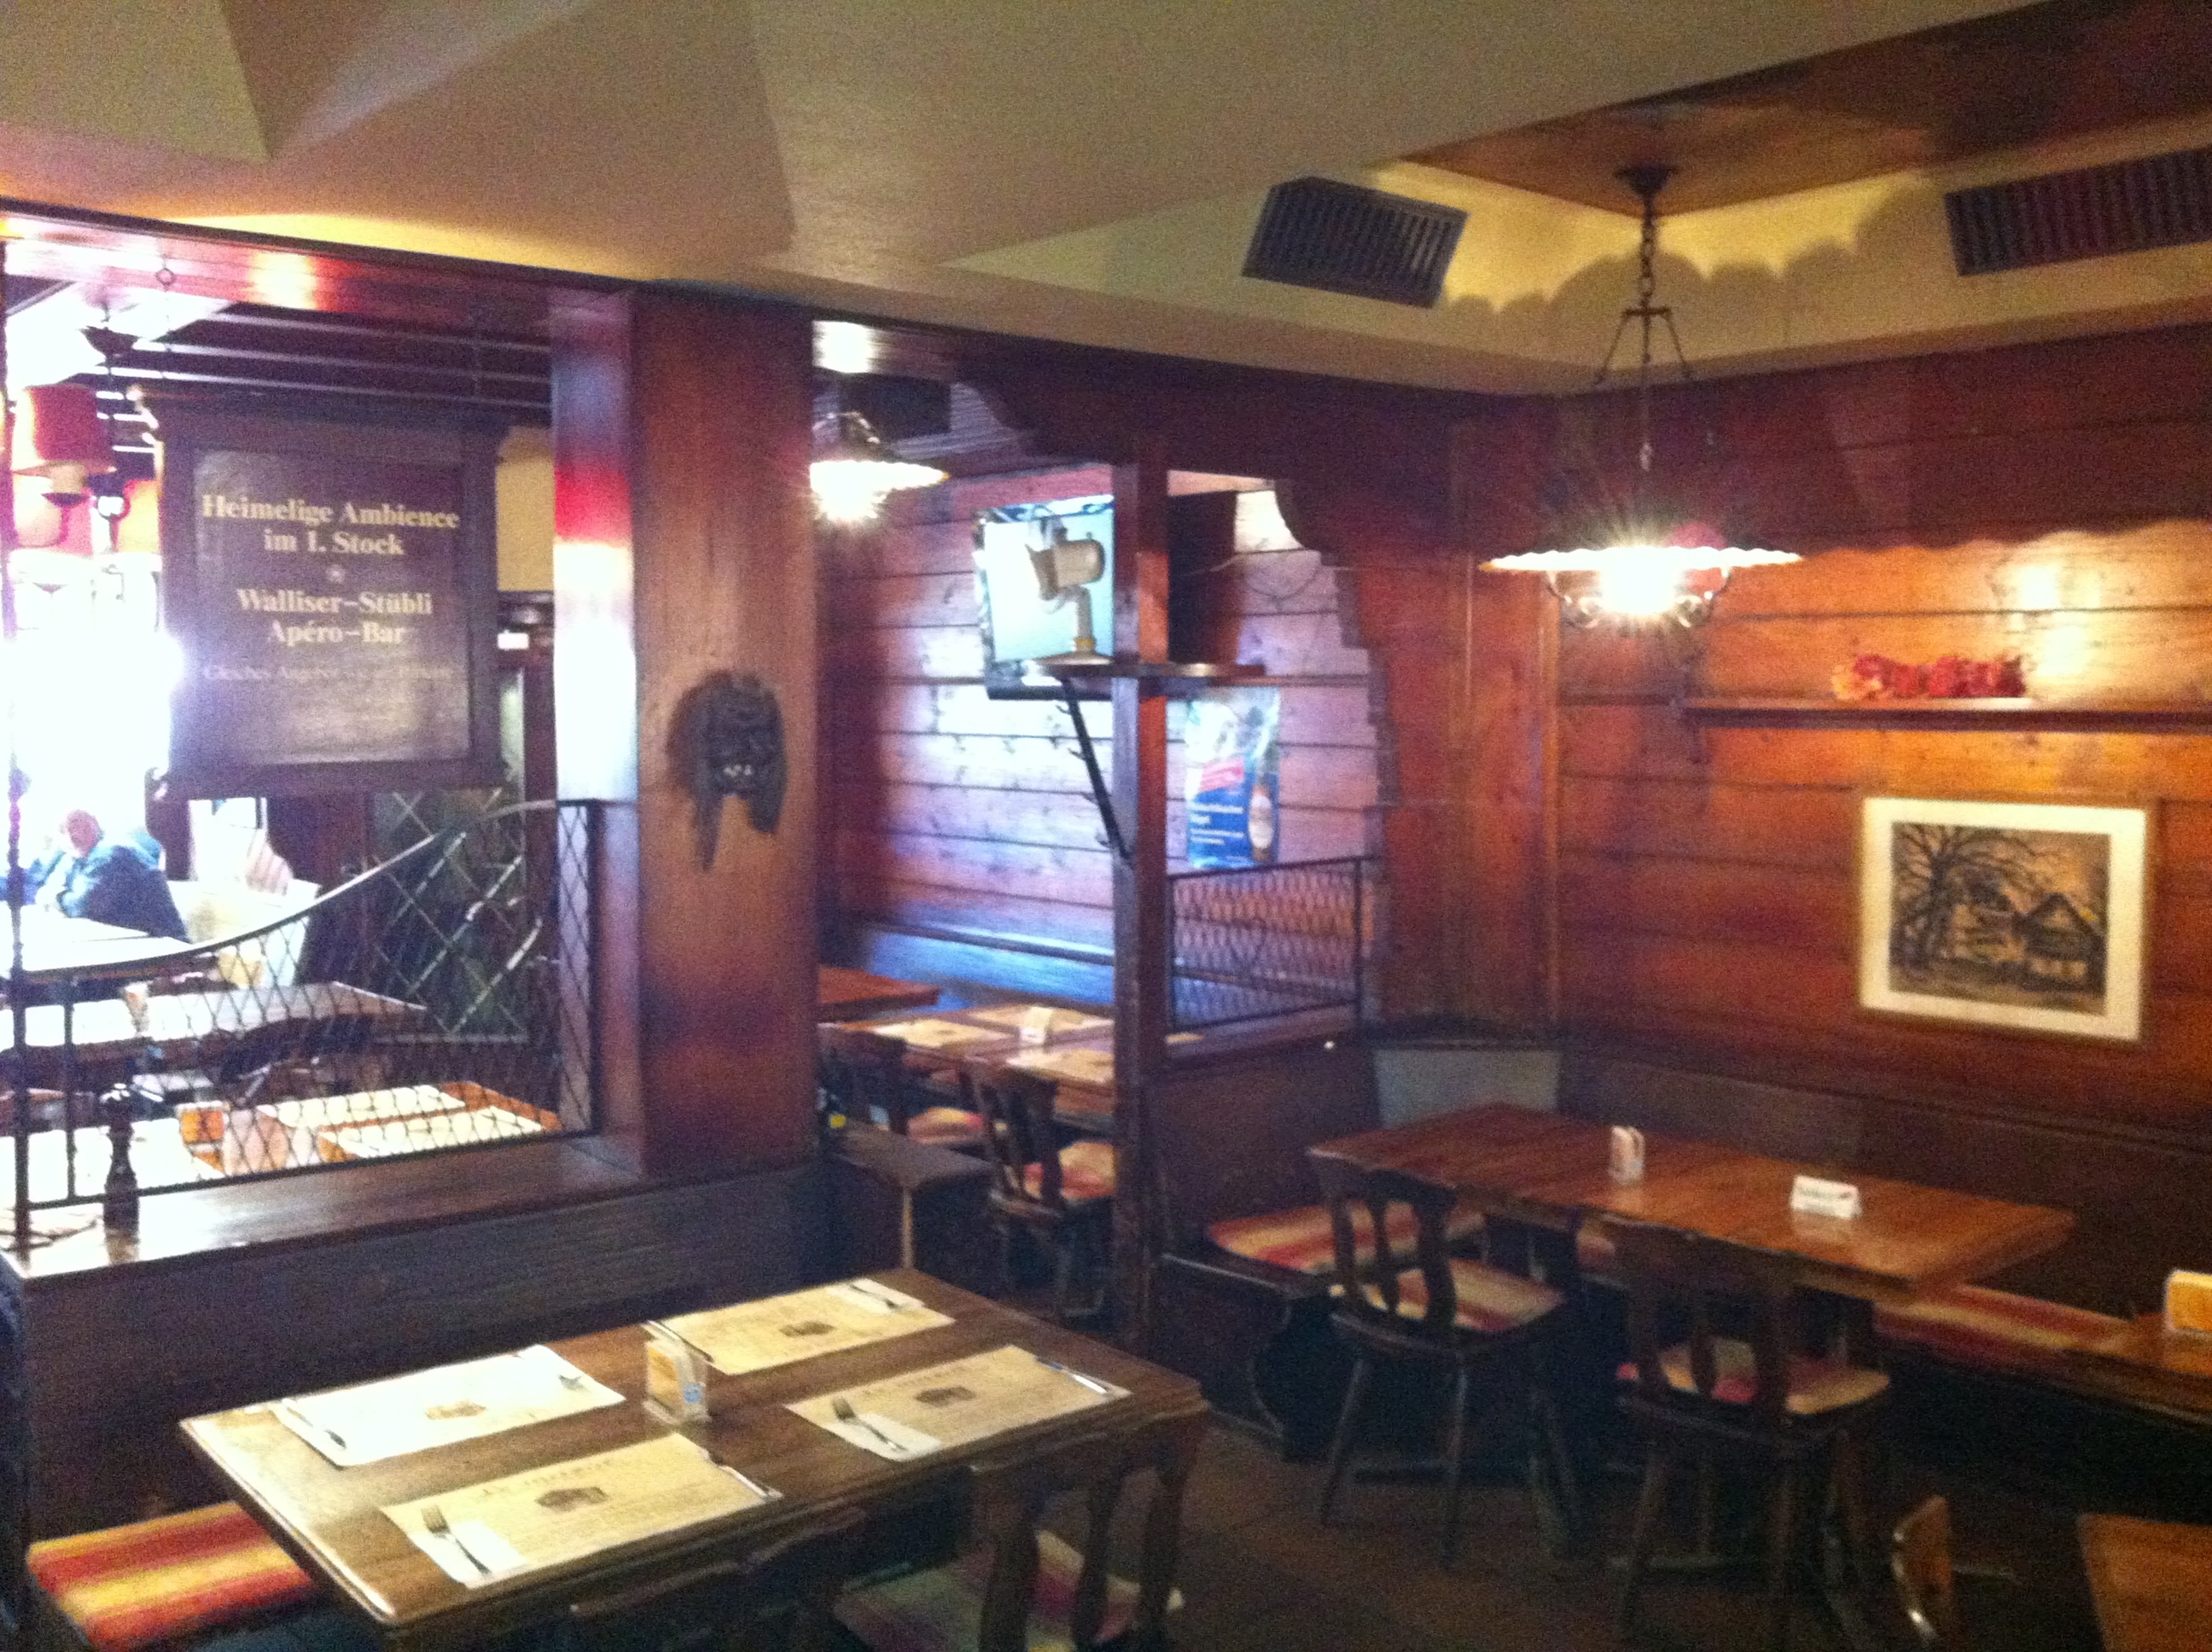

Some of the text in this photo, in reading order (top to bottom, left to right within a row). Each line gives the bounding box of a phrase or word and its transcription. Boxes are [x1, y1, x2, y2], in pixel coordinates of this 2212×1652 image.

[203, 494, 460, 528] Heimelige Ambience
[265, 529, 296, 551] im
[333, 532, 405, 555] Stock
